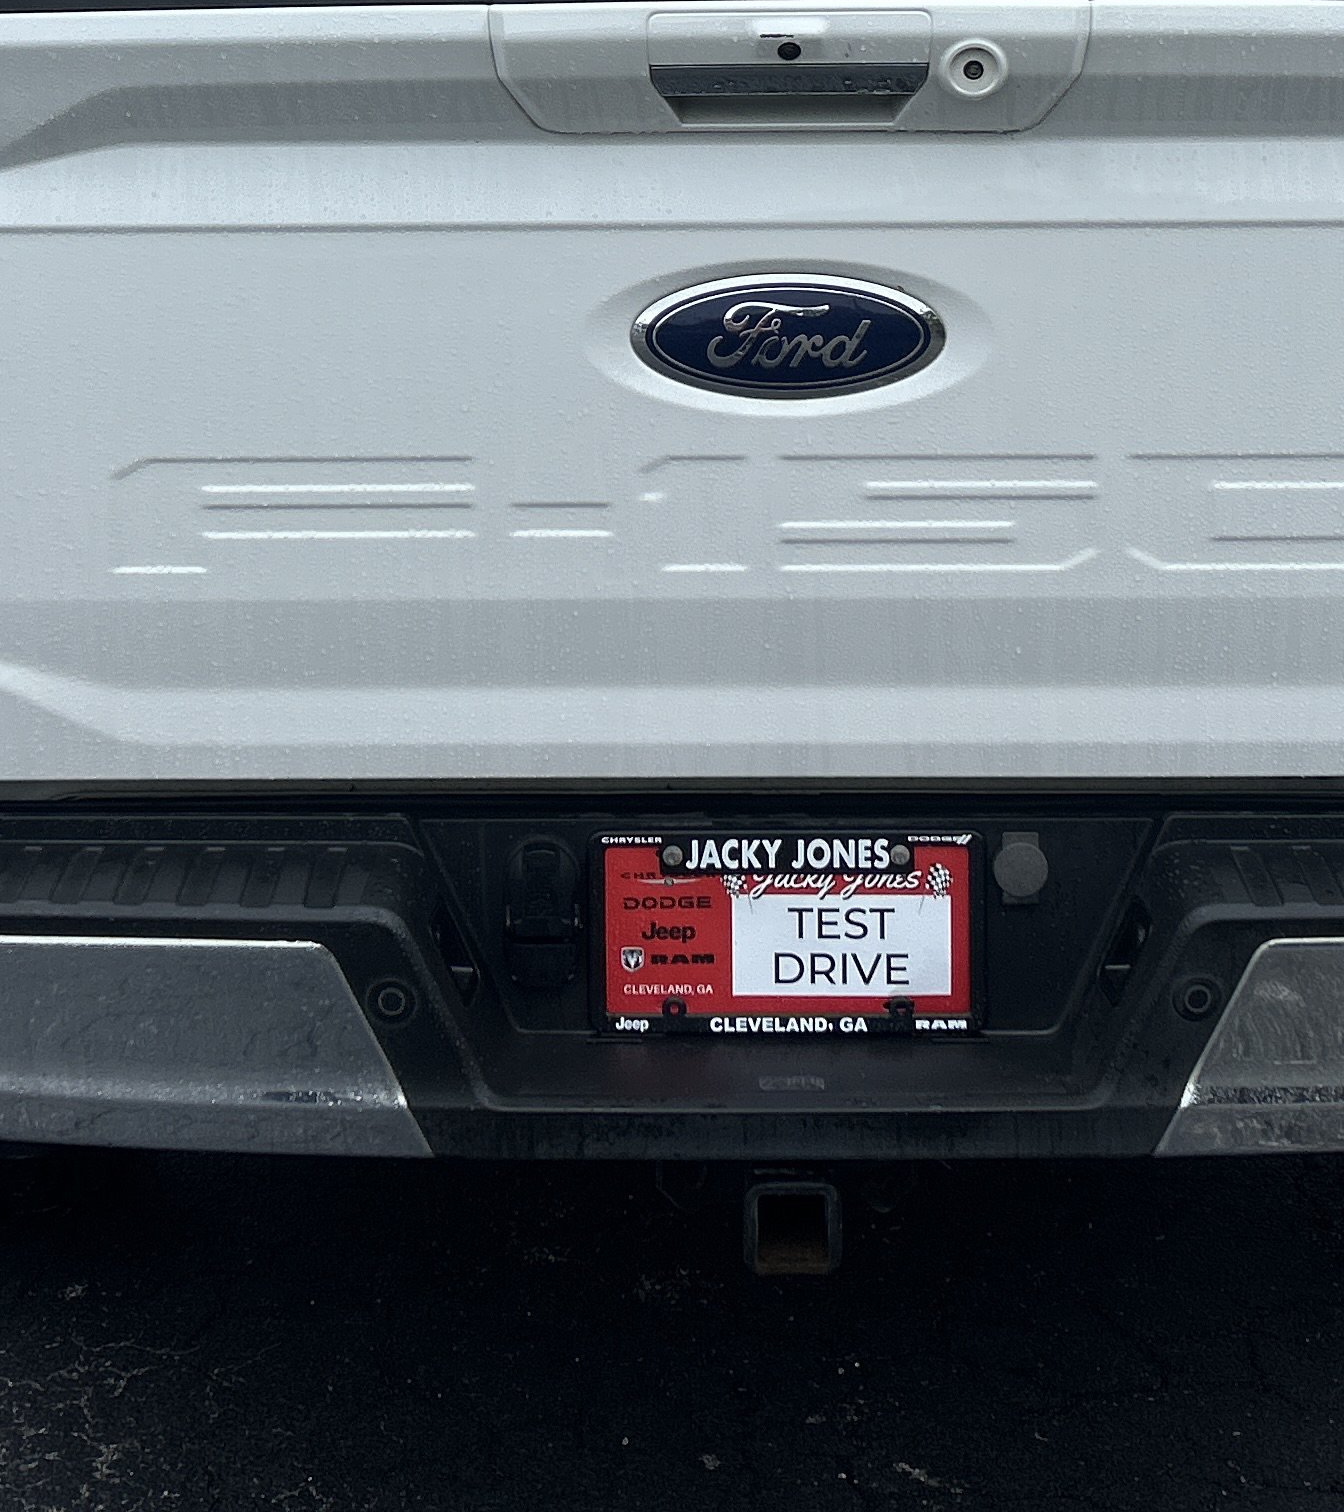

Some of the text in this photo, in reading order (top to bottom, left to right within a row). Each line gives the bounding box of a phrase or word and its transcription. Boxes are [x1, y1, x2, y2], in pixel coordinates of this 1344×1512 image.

[706, 301, 871, 368] Ford
[685, 838, 890, 869] JACKY JONES
[623, 896, 712, 910] DODGE
[787, 907, 895, 939] TEST
[641, 922, 696, 943] Jeep
[651, 954, 715, 965] RAM
[774, 952, 909, 985] DRIVE
[623, 984, 713, 995] CLEVELAND, GA
[615, 1017, 649, 1032] Jeep
[710, 1017, 868, 1032] CLEVELAND, GA
[915, 1019, 968, 1030] RAM
